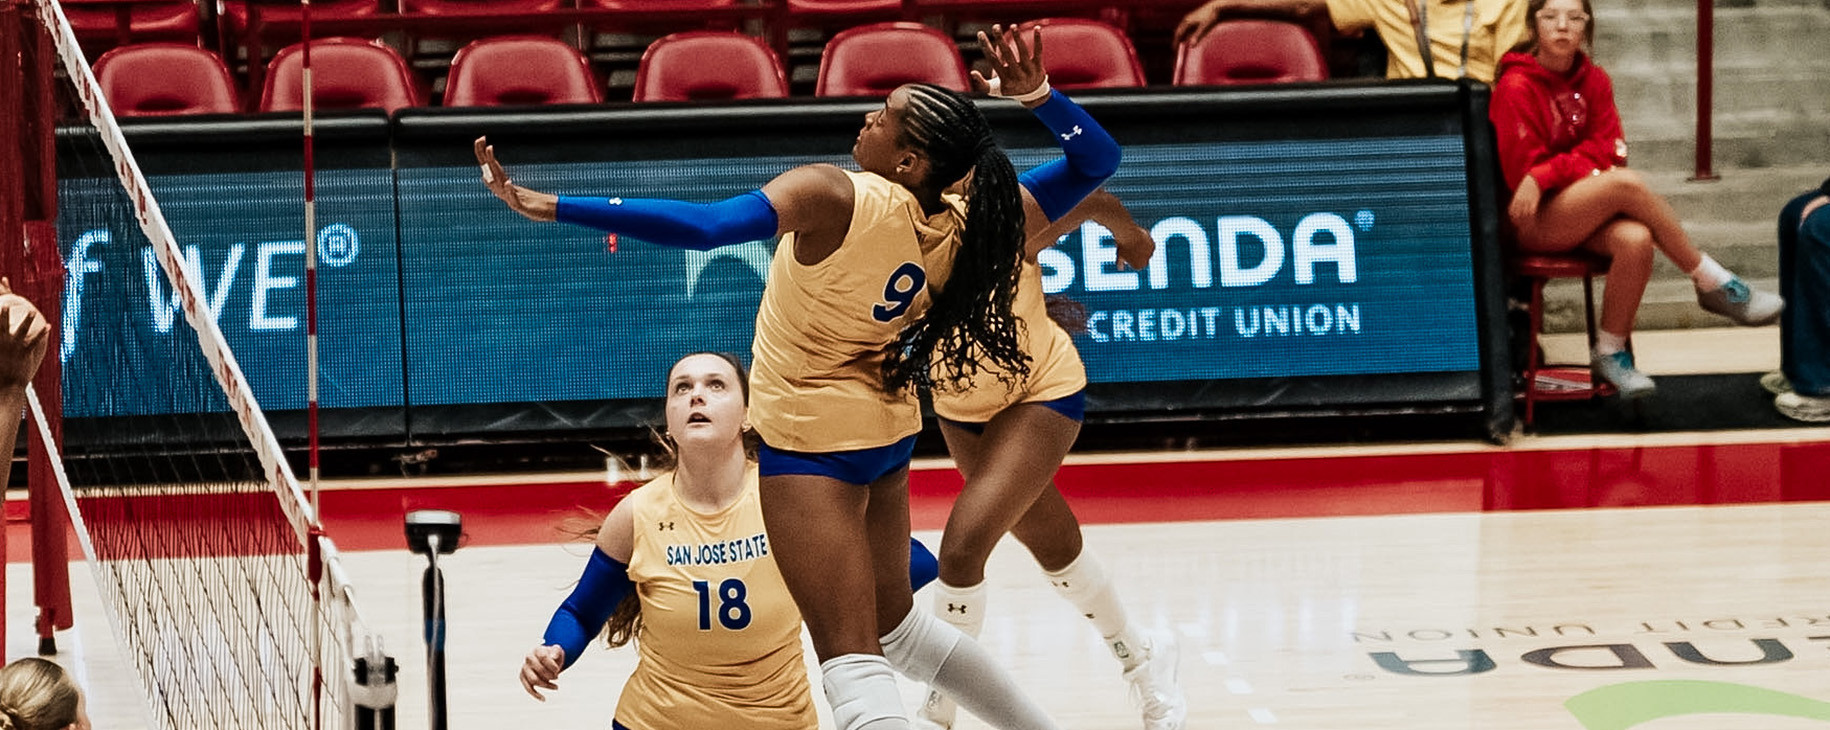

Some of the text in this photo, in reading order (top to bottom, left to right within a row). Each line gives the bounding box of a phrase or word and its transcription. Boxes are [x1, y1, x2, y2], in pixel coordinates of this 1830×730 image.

[872, 261, 927, 324] 9
[1086, 303, 1361, 342] CREDIT UNION
[666, 533, 768, 566] SAN JOSÉ STATE
[691, 578, 752, 631] 18
[1350, 624, 1597, 643] UNION
